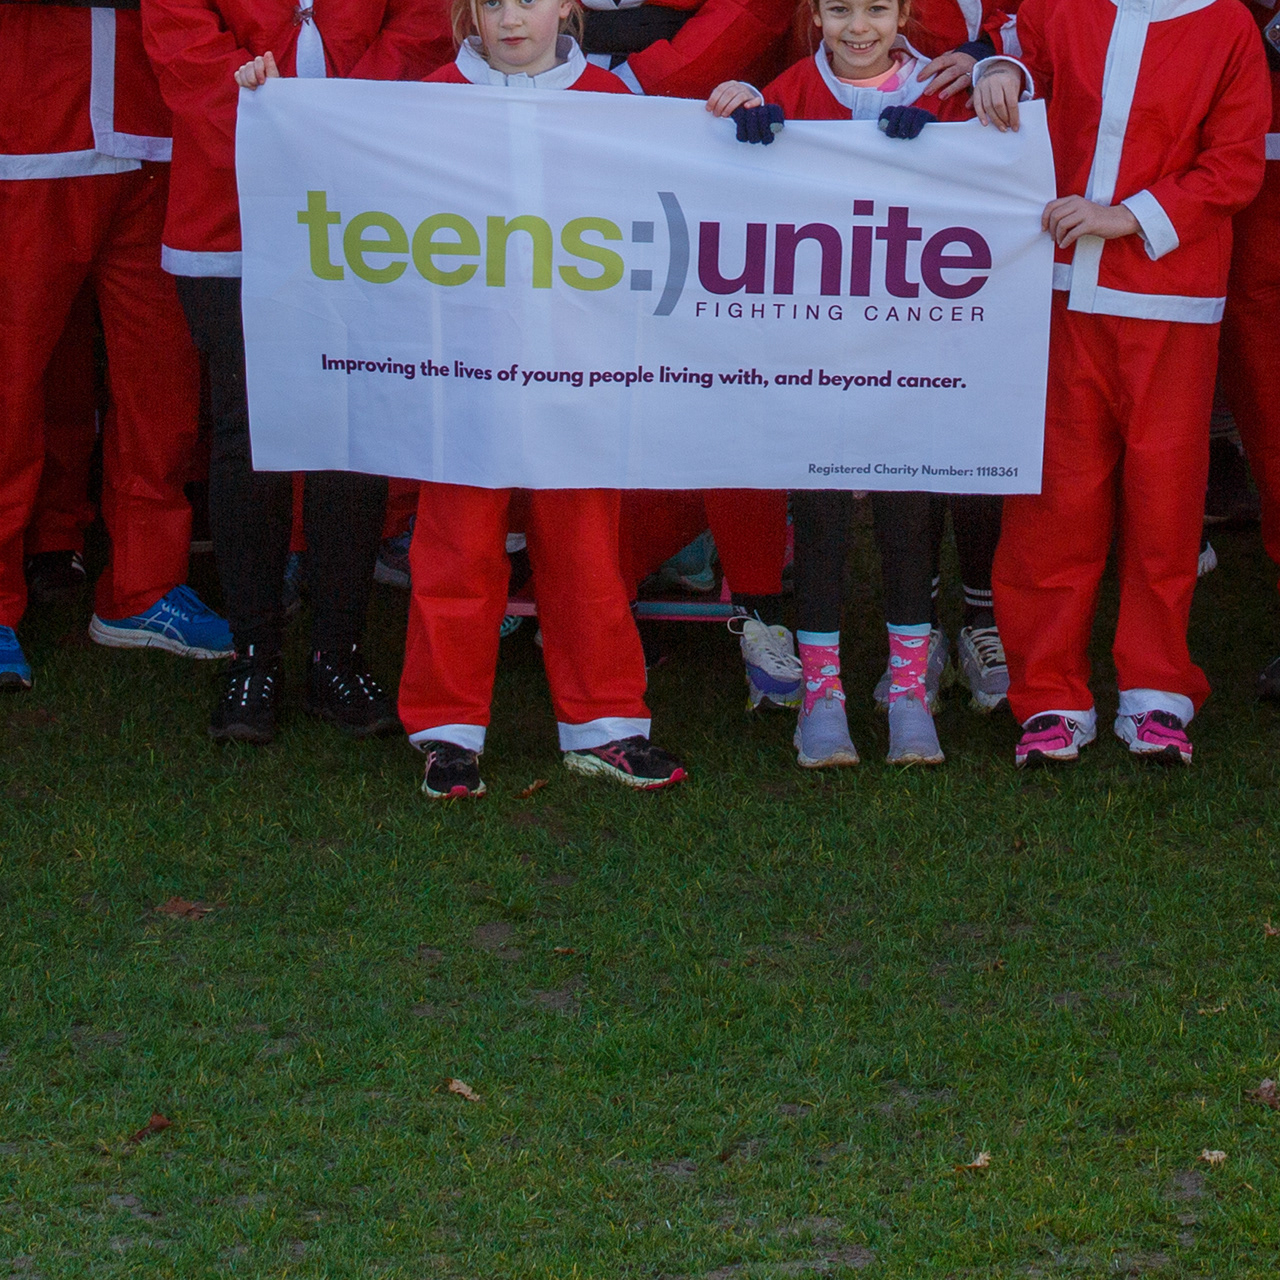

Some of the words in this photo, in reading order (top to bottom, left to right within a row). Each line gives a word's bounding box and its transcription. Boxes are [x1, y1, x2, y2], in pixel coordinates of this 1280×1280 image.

[696, 301, 843, 320] FIGHTING
[864, 306, 985, 322] CANCER
[322, 354, 416, 381] Improving
[420, 360, 450, 377] the
[454, 360, 493, 381] lives
[496, 362, 518, 382] of
[522, 368, 583, 388] young
[589, 365, 655, 388] people
[659, 365, 714, 389] living
[719, 366, 769, 389] with,
[775, 368, 814, 389] and
[819, 369, 893, 392] beyond
[897, 376, 967, 389] cancer.
[808, 463, 871, 476] Registered
[873, 463, 919, 477] Charity
[921, 465, 974, 477] Number:
[976, 466, 1019, 478] 1118361
